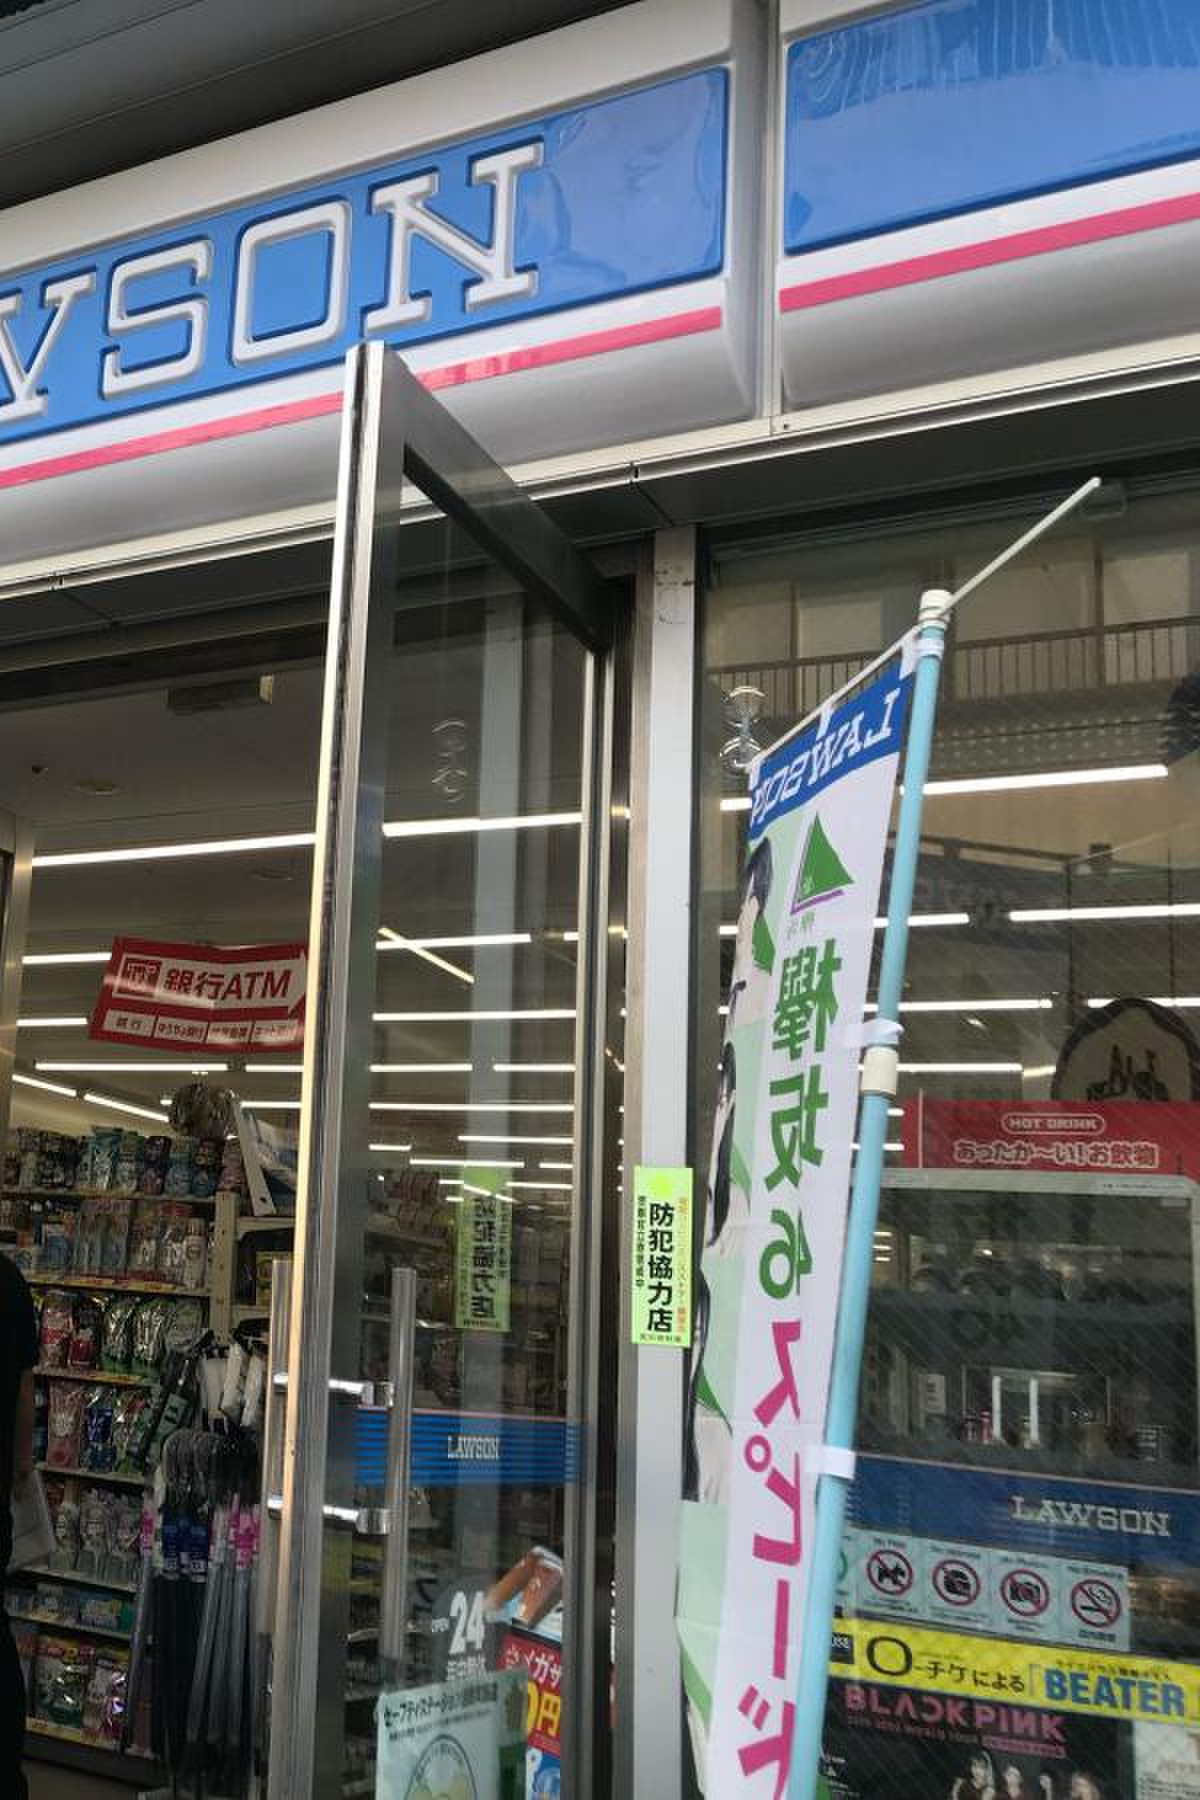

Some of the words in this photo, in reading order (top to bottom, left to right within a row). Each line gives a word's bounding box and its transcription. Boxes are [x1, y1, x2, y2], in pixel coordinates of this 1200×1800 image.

[163, 967, 292, 1000] 銀行ATM
[1009, 1116, 1041, 1129] HOT
[647, 1203, 675, 1334] 防犯協力店
[447, 1435, 500, 1460] LAWSON
[1010, 1496, 1172, 1537] LAWSON
[449, 1592, 485, 1654] 24
